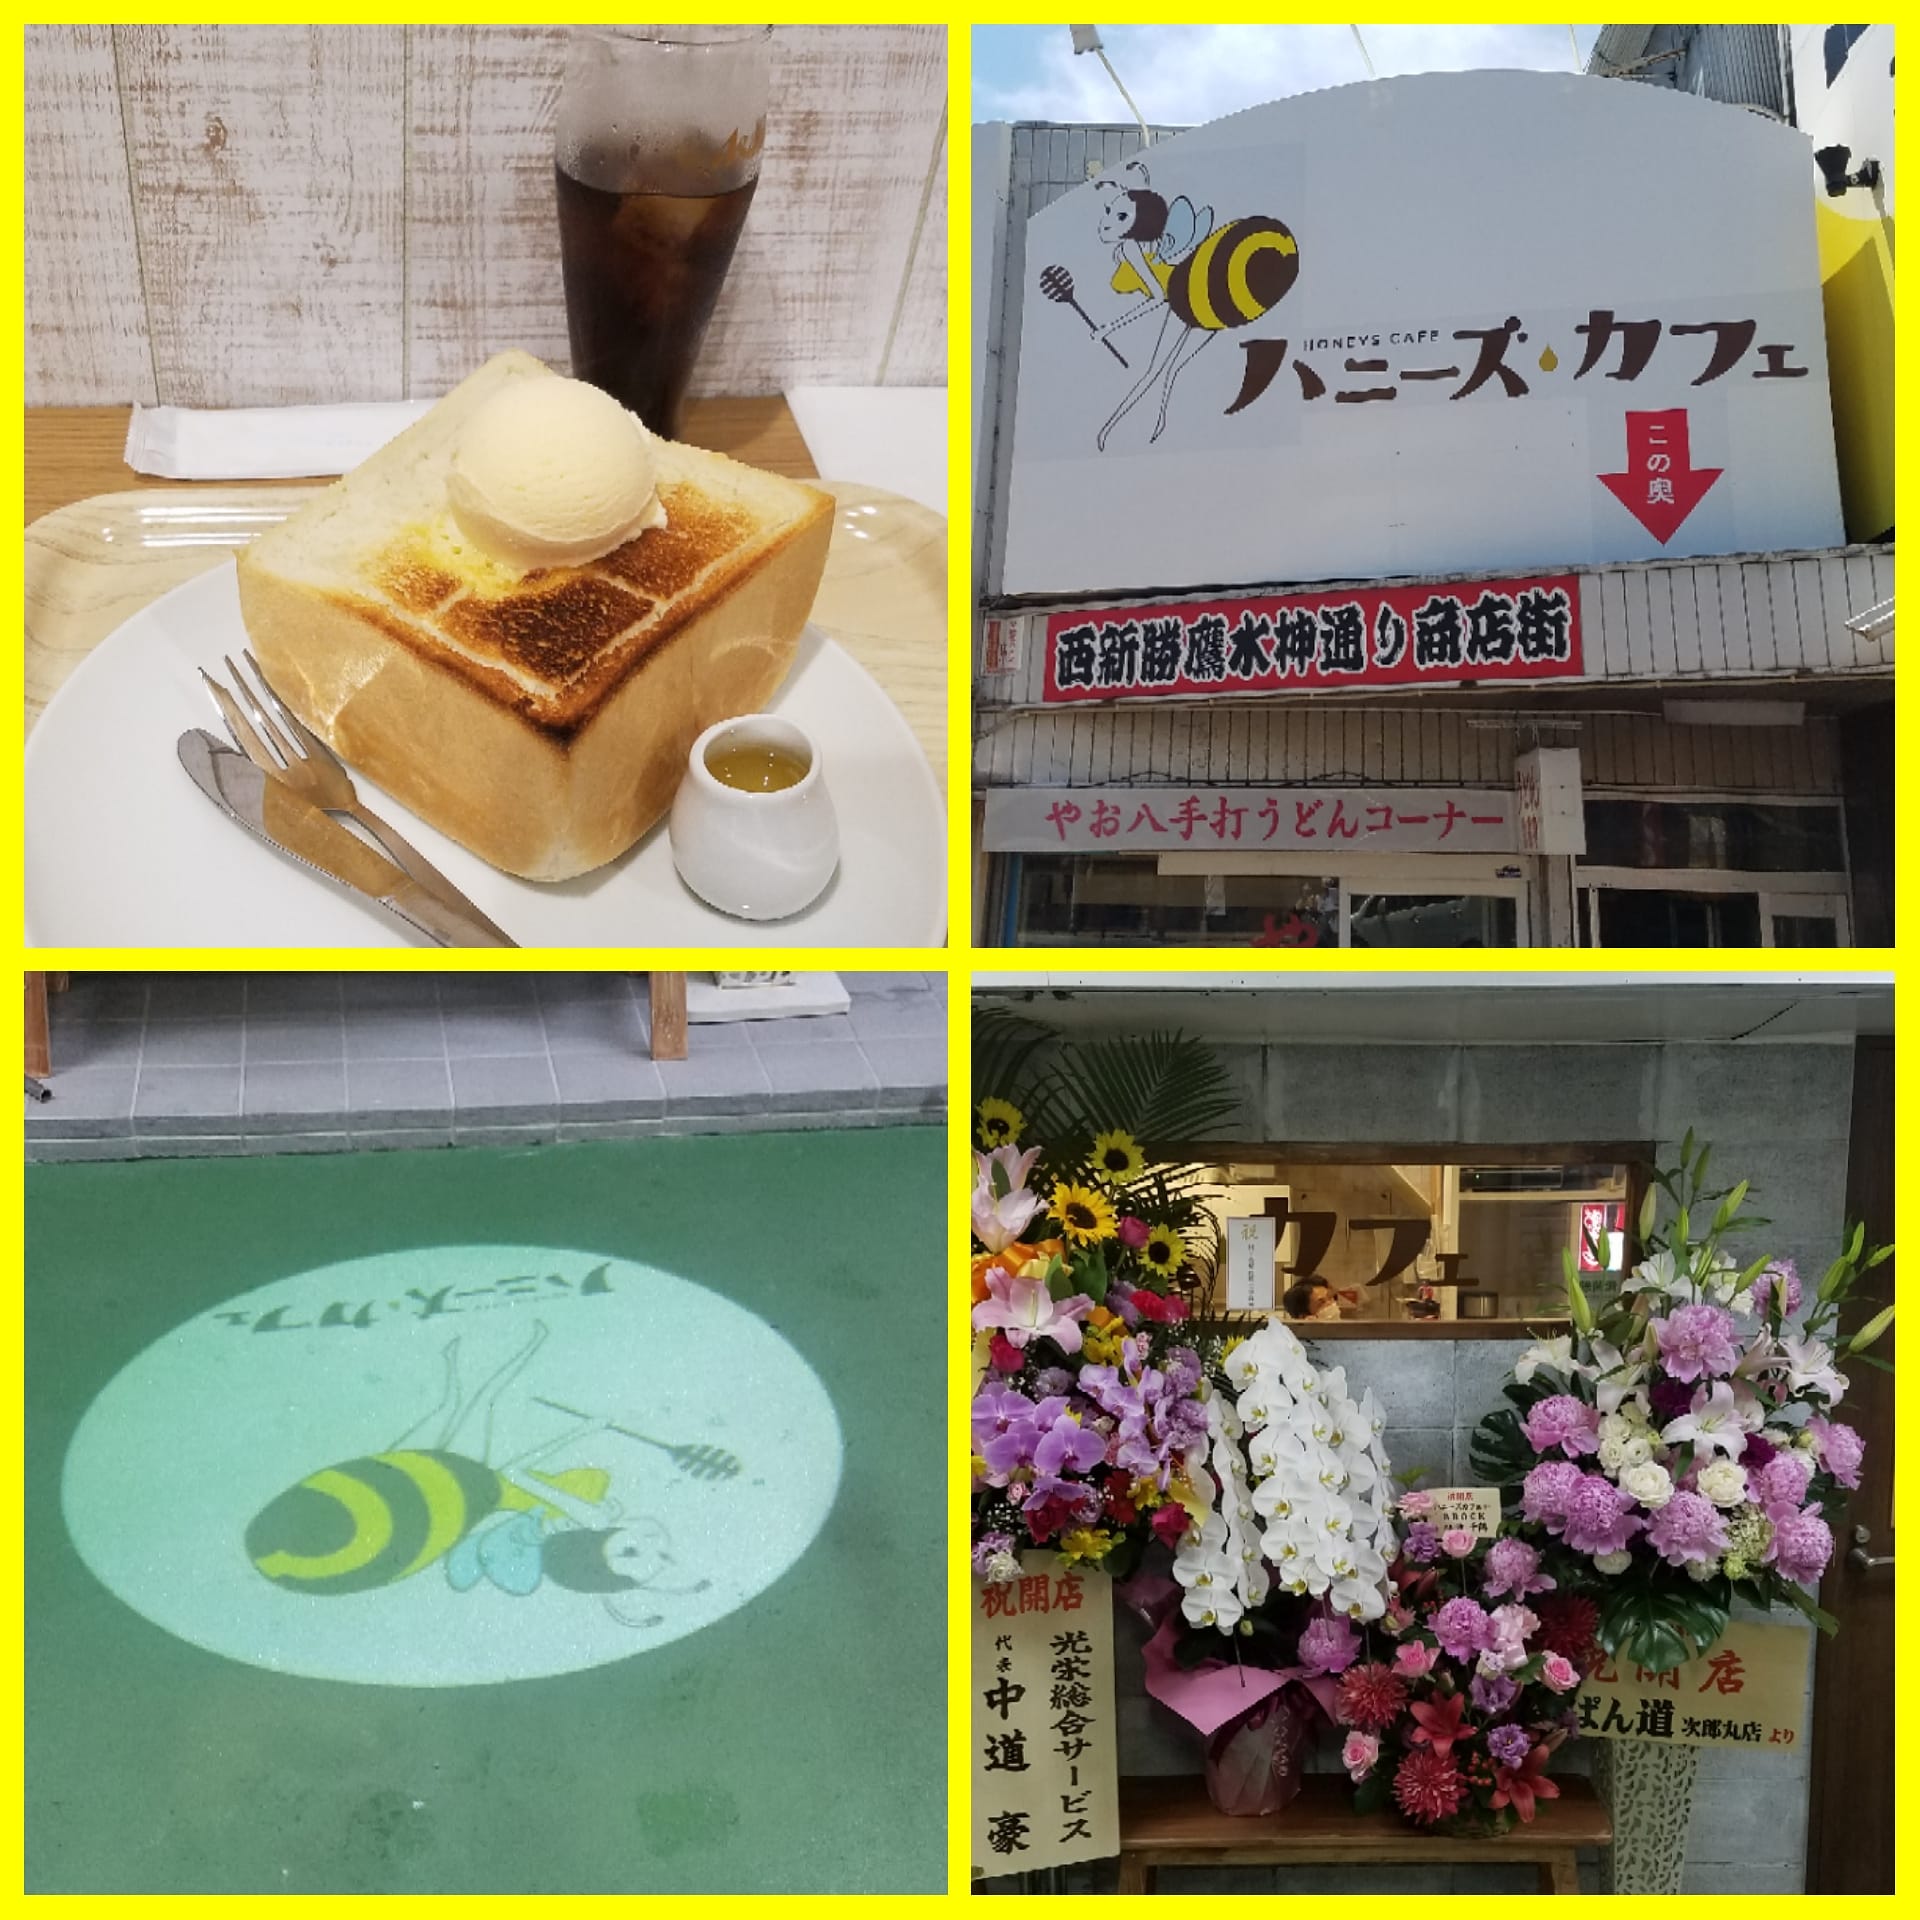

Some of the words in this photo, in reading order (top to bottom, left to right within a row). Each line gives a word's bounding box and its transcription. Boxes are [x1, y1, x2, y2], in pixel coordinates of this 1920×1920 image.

[1303, 334, 1381, 351] HONEYS
[1389, 330, 1440, 345] CAFE
[1646, 424, 1675, 505] この奥
[1055, 587, 1572, 692] 西新勝鷹水神通り商店街
[1045, 795, 1504, 841] やお八手打うどんコーナー
[1249, 1197, 1479, 1287] カフェ
[980, 1571, 1085, 1619] 祝開店
[1049, 1630, 1096, 1843] 光栄総合サービス
